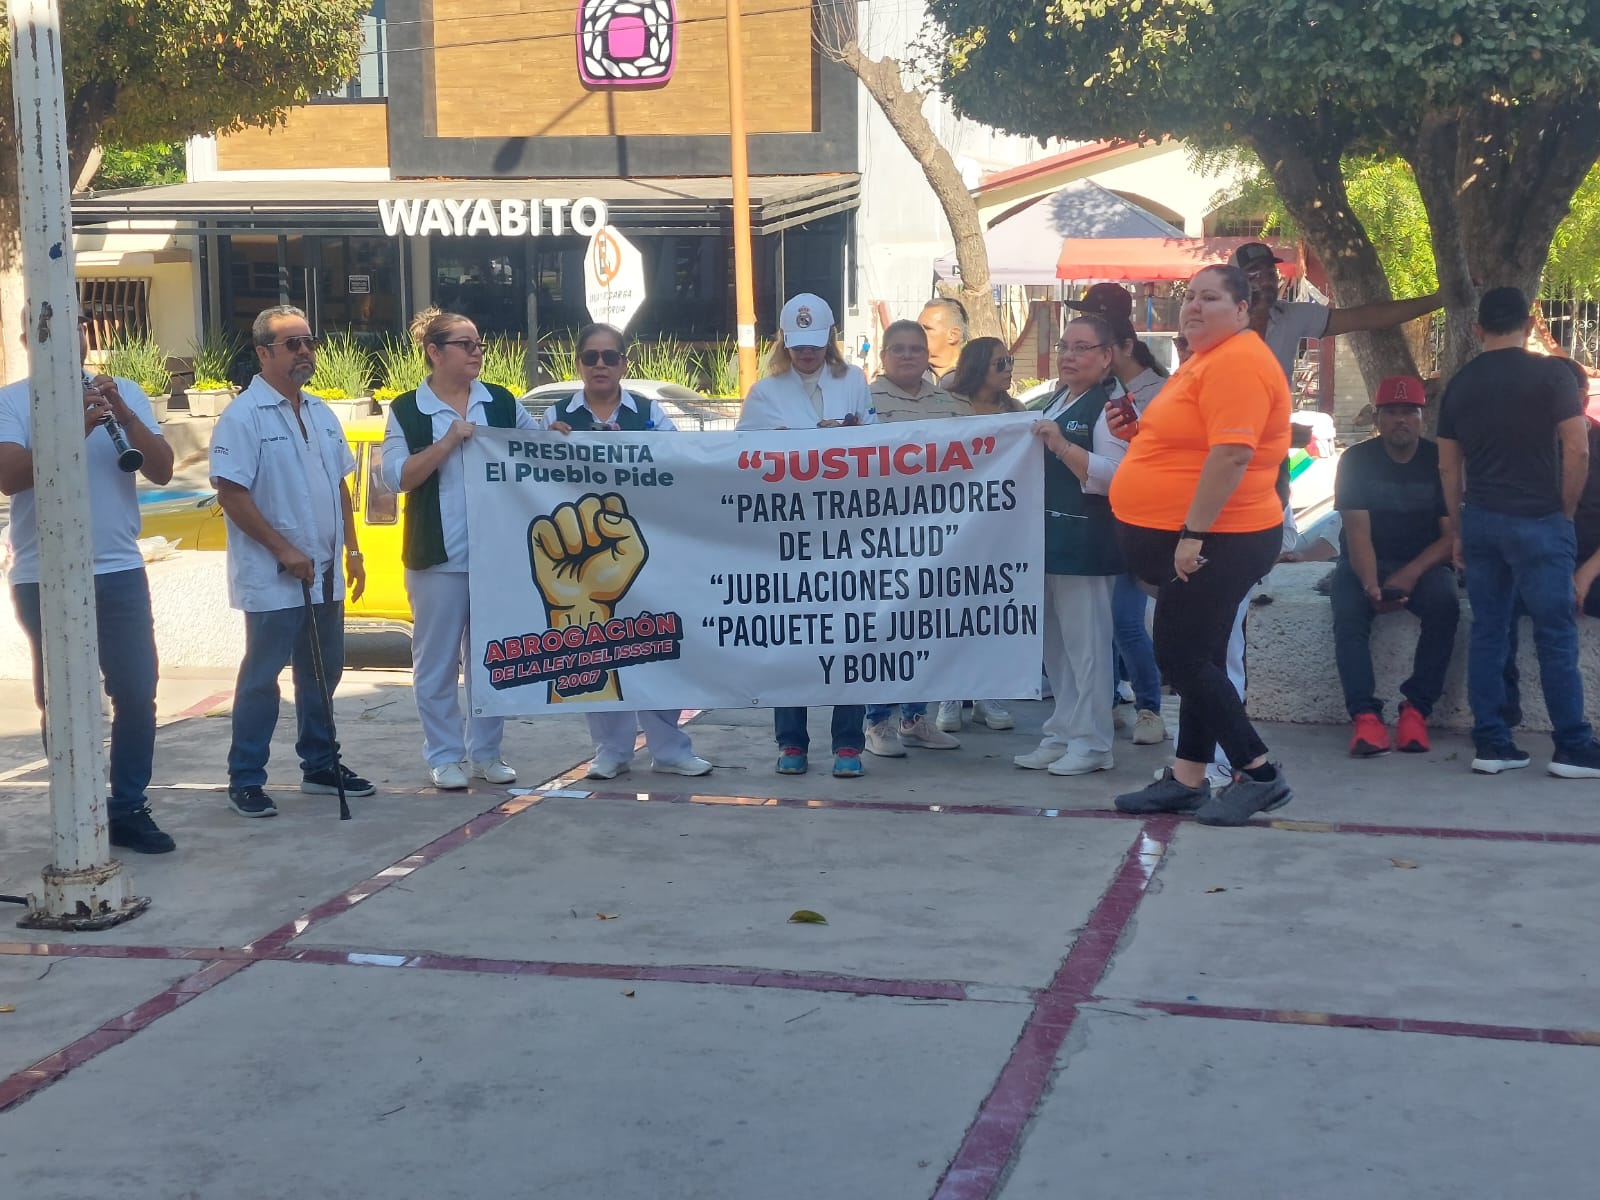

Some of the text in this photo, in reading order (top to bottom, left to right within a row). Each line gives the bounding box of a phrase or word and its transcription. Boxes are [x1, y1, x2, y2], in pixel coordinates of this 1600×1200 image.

[377, 197, 607, 237] WAYABITO
[508, 440, 654, 464] PRESIDENTA
[737, 436, 996, 483] “JUSTICIA”
[486, 462, 674, 487] El Pueblo Pide
[721, 479, 1017, 523] “PARA TRABAJADORES
[779, 524, 959, 561] DE LA SALUD”
[710, 562, 1028, 605] “JUBILACIONES DIGNAS”
[485, 612, 676, 664] ABROGACIÓN
[702, 598, 1037, 648] “PAQUETE DE JUBILACIÓN
[491, 640, 673, 683] DE LA LEY DEL ISSSTE
[556, 670, 601, 690] 2007
[818, 650, 930, 685] Y BONO”
